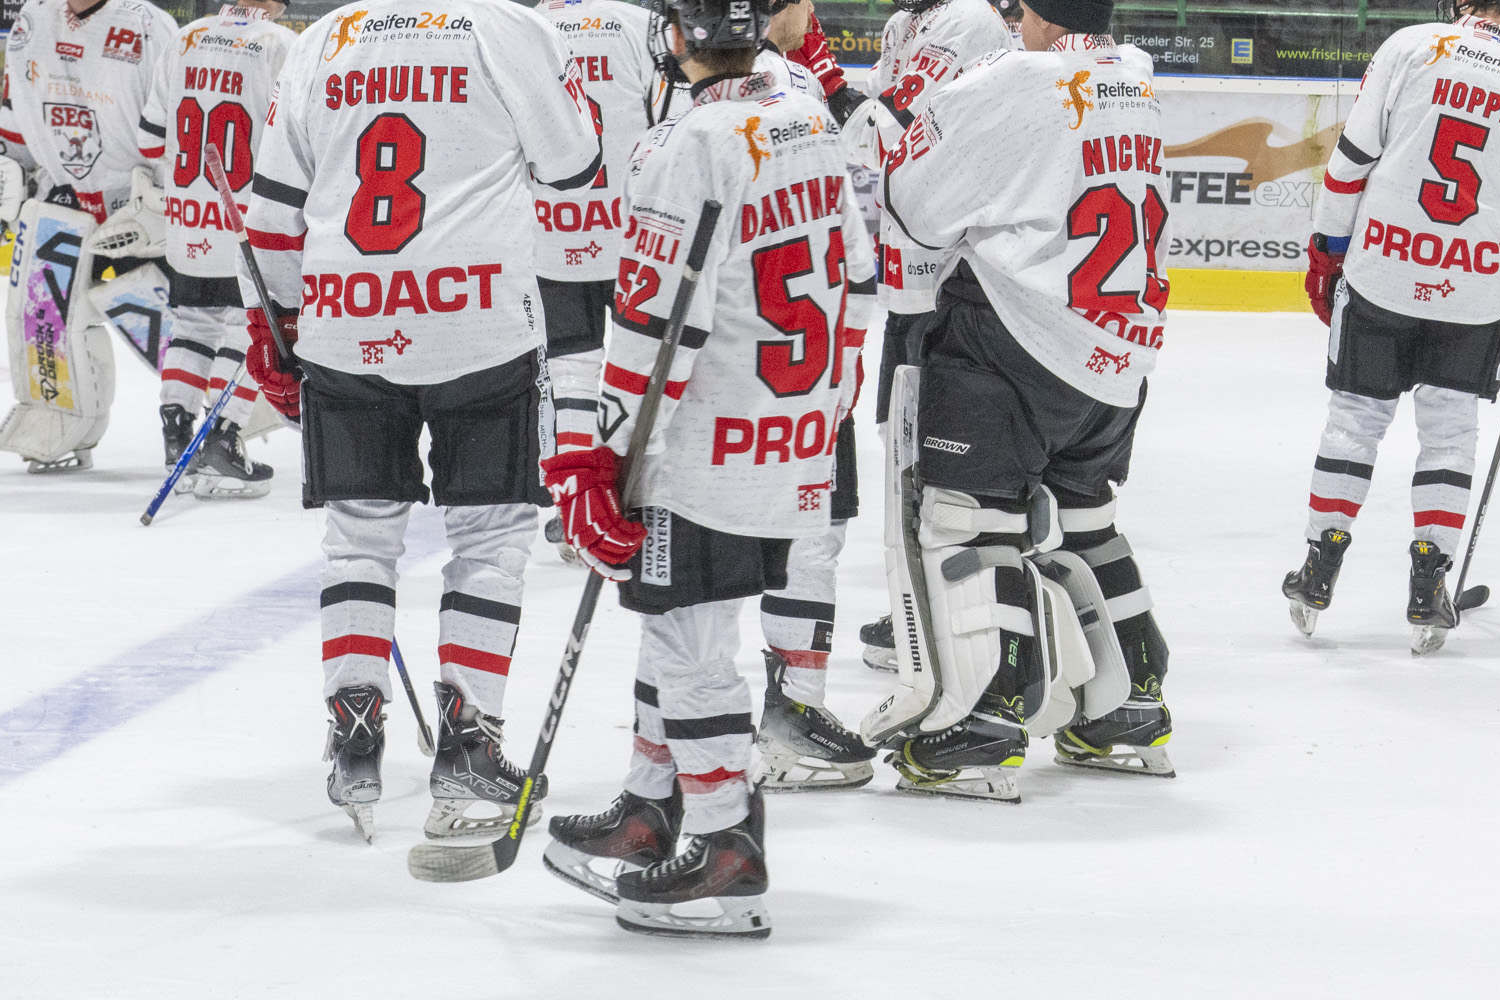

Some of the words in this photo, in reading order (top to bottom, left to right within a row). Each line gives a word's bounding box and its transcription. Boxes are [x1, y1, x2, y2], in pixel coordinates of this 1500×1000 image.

[362, 12, 473, 34] Reifen24.de
[729, 1, 750, 20] 52
[201, 34, 262, 53] Reifen24.de
[359, 35, 378, 44] Wir
[382, 33, 419, 42] geben
[426, 31, 472, 41] Gummi!
[567, 31, 584, 40] ben
[1123, 34, 1171, 47] Eickeler
[1175, 37, 1195, 48] Str.
[1200, 38, 1214, 48] 25
[574, 56, 614, 82] TEL
[1152, 51, 1199, 64] e-Eickel
[1276, 48, 1373, 62] www.frische-rev
[1454, 55, 1469, 64] Wir
[184, 66, 243, 96] MOYER
[325, 65, 468, 110] SCHULTE
[51, 106, 94, 130] SEG
[1098, 100, 1115, 110] Wir
[1120, 99, 1146, 109] geben
[173, 96, 253, 193] 90
[344, 112, 426, 256] 8
[1418, 113, 1490, 226] 5
[1166, 171, 1253, 205] FEE
[535, 196, 622, 233] ROA
[10, 221, 27, 287] CCM
[1168, 236, 1308, 262] express-
[301, 263, 502, 319] PROACT
[615, 256, 661, 327] 52
[36, 323, 47, 377] DRUCK
[45, 322, 57, 380] DESIGN
[711, 405, 841, 466] PRO
[925, 437, 968, 453] BROWN
[902, 593, 922, 673] WARRIOR
[452, 764, 513, 801] VAPOR
